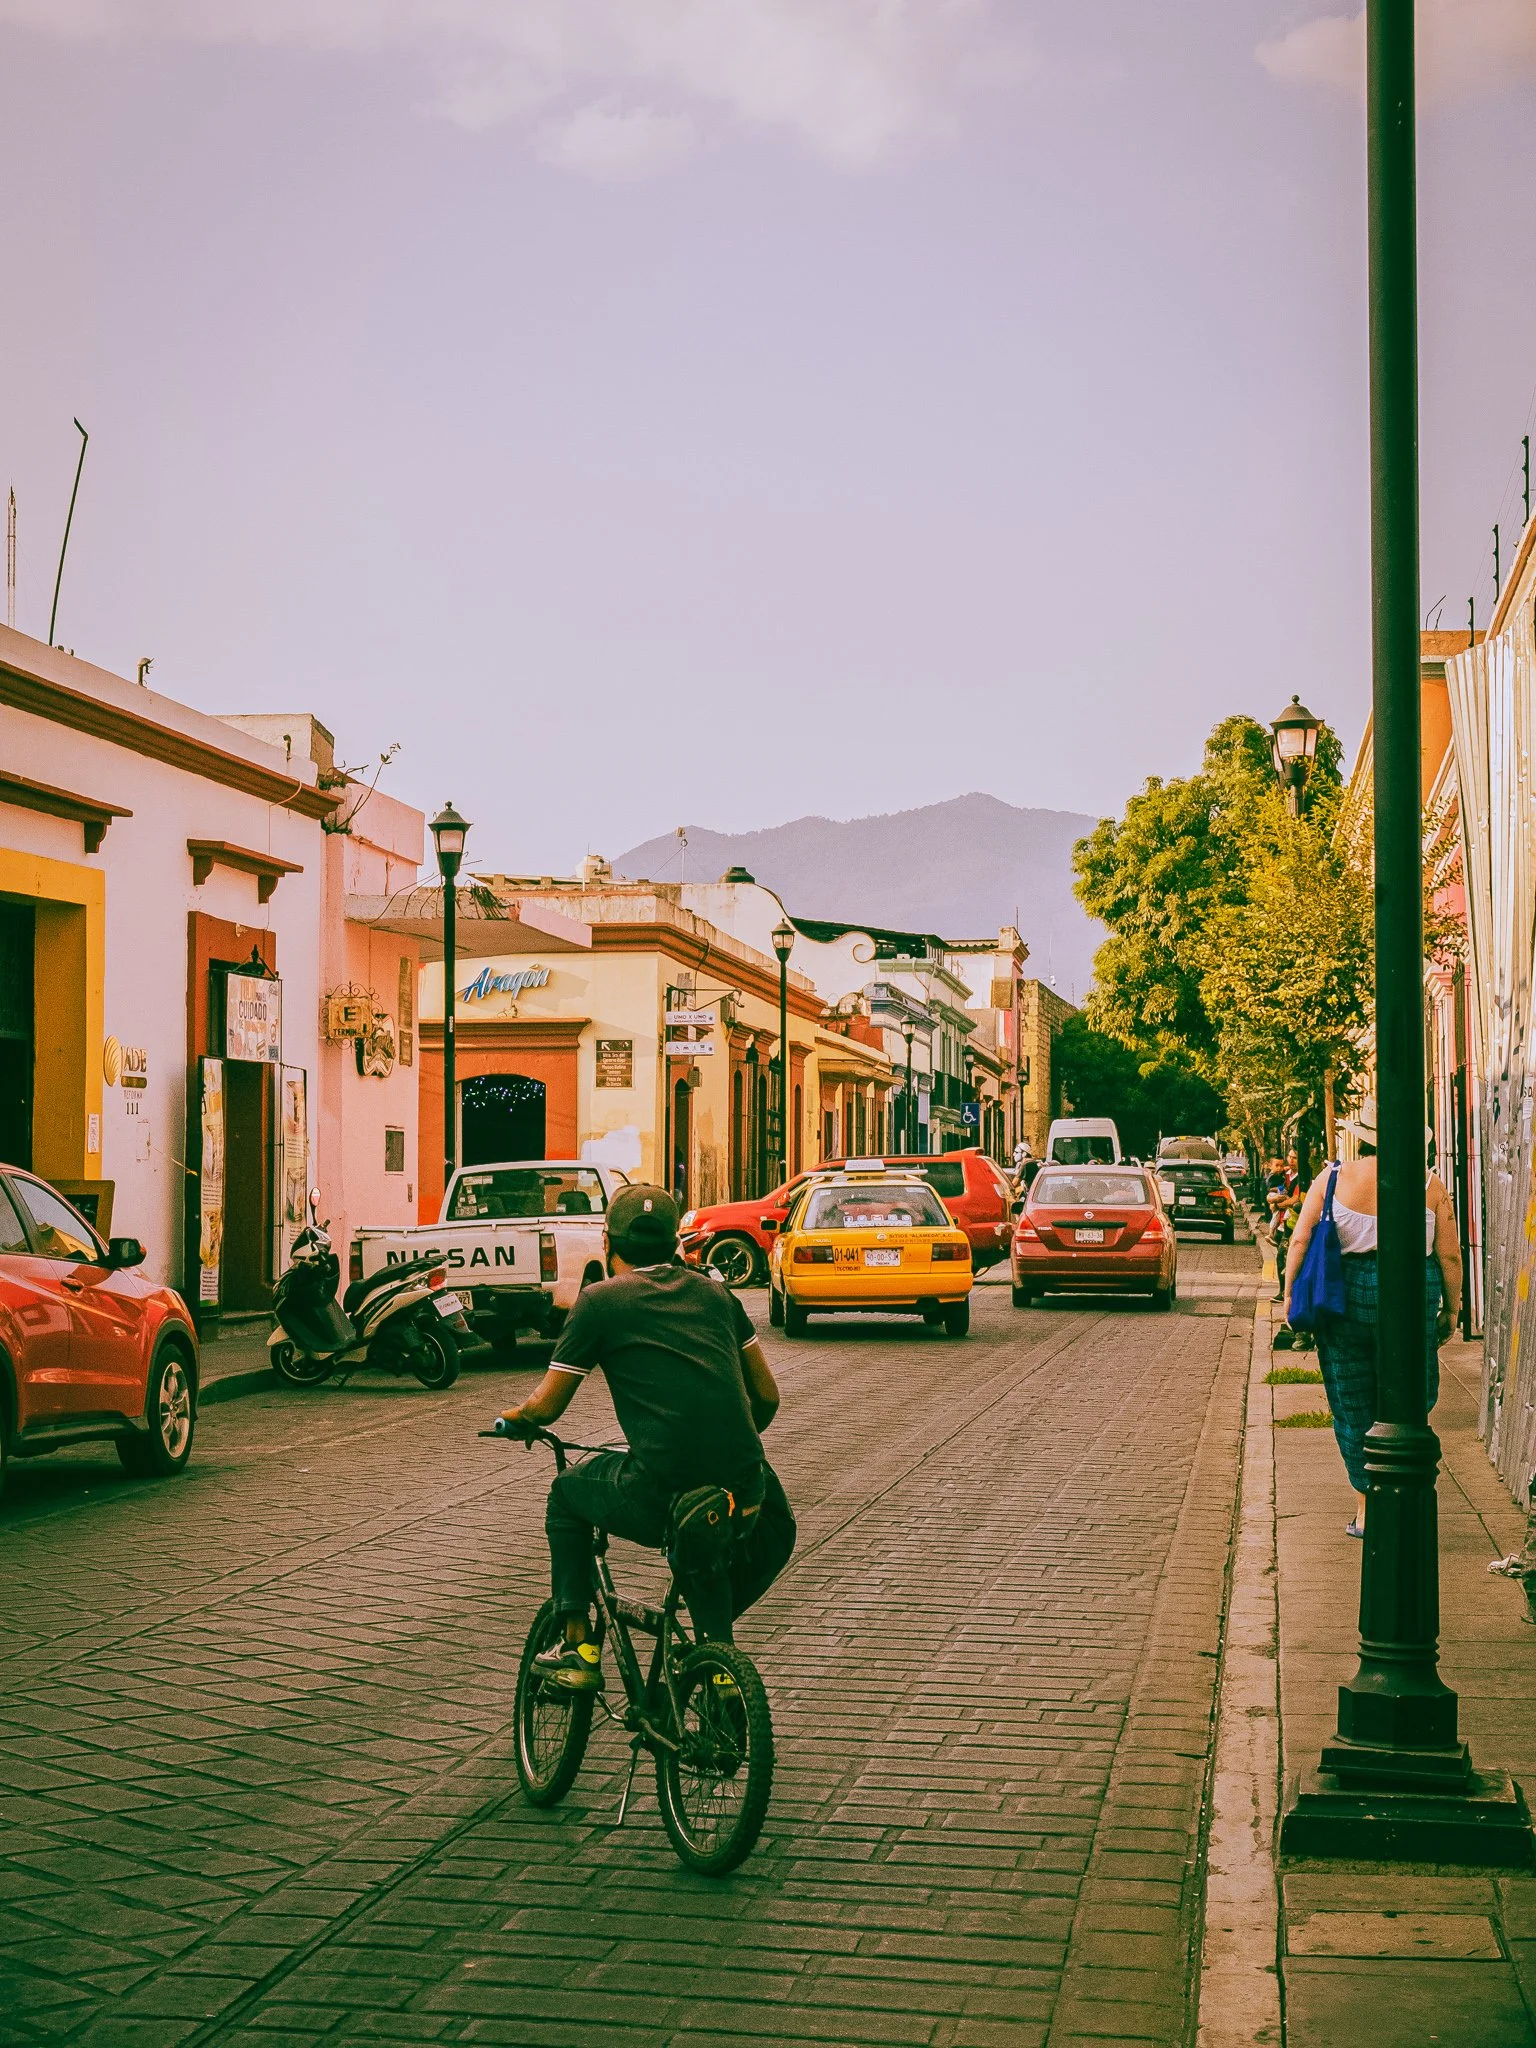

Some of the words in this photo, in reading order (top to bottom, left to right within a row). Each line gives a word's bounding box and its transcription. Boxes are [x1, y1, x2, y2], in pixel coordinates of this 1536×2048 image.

[462, 964, 551, 1003] Aragón
[239, 1001, 267, 1021] CUIDADO
[834, 1247, 859, 1262] 01-041
